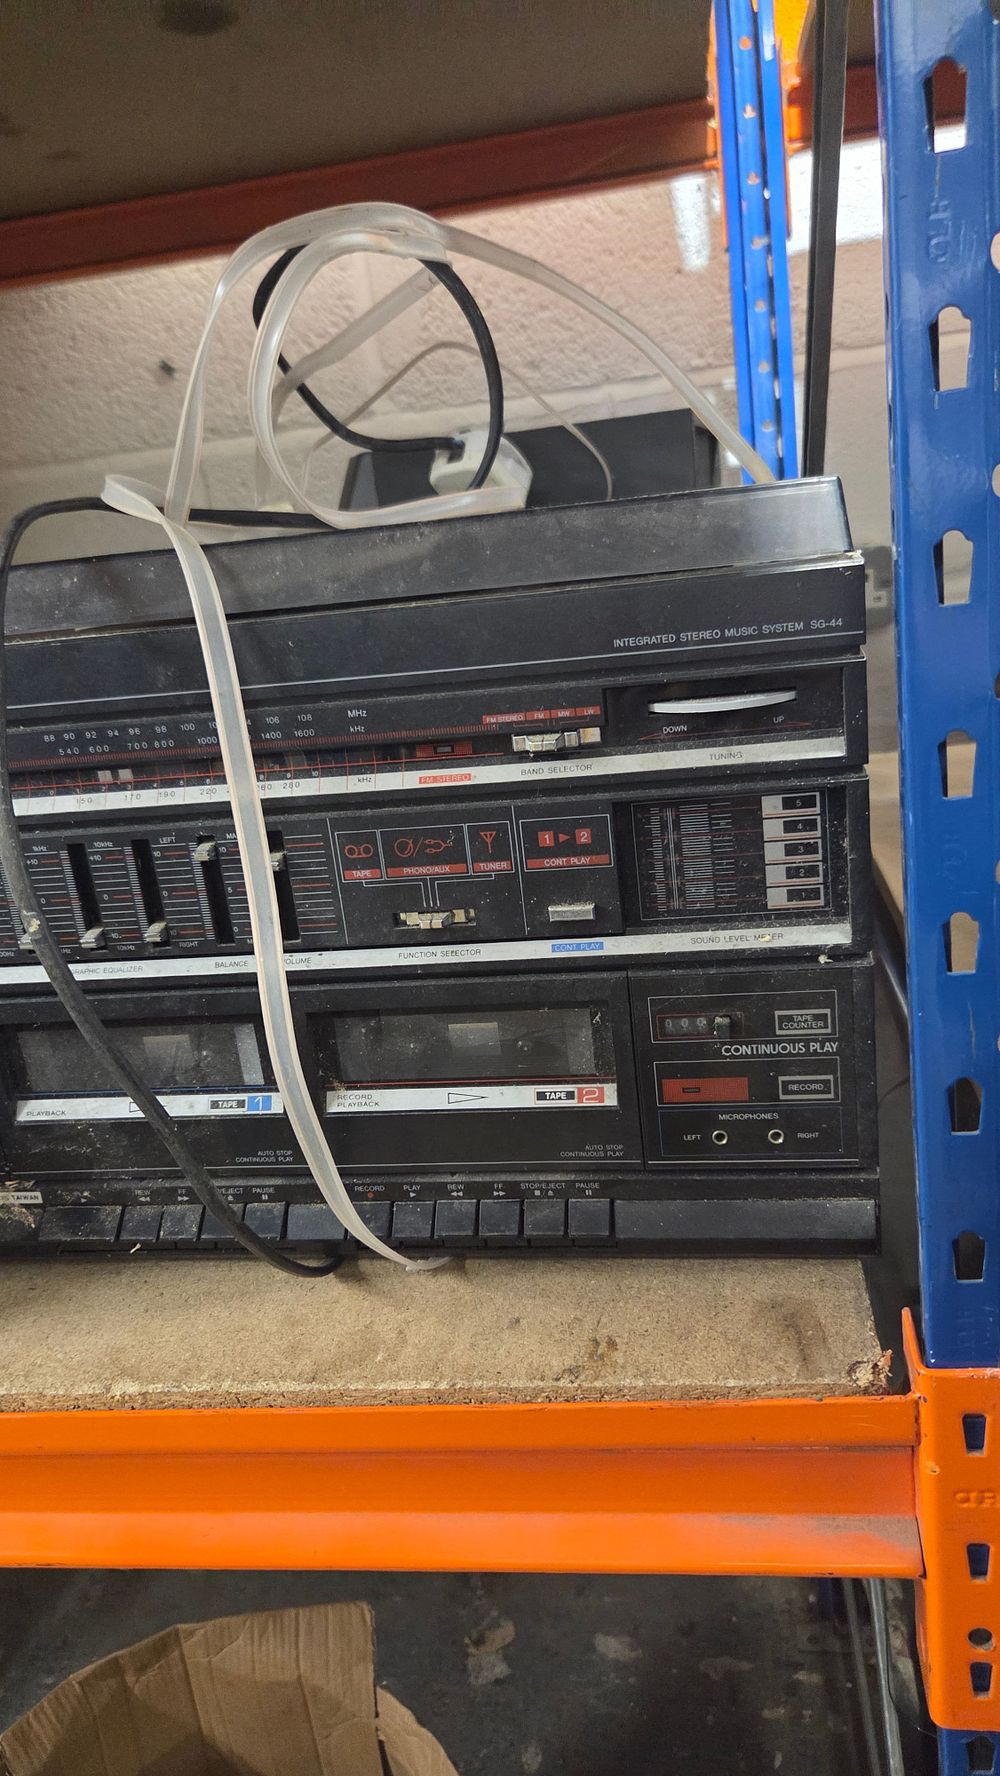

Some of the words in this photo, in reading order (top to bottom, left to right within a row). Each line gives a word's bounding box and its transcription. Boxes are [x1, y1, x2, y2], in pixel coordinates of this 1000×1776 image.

[614, 634, 676, 648] INTEGRATED
[680, 630, 720, 642] STEREO
[725, 626, 758, 638] MUSIC
[762, 622, 804, 634] SYSTEM
[810, 618, 843, 630] SG-44
[498, 714, 524, 722] STEREO
[773, 715, 785, 724] UP
[63, 732, 76, 740] 90
[85, 731, 97, 740] 92
[107, 729, 119, 738] 94
[128, 728, 141, 736] 96
[154, 725, 168, 734] 98
[180, 722, 196, 731] 100
[208, 721, 218, 729] 10
[266, 716, 280, 724] 106
[297, 714, 313, 722] 108
[348, 709, 368, 718] MHz
[662, 724, 688, 735] DOWN
[58, 747, 80, 756] 540
[89, 744, 110, 754] 600
[127, 742, 148, 750] 700
[154, 740, 175, 748] 800
[197, 736, 218, 744] 1000
[261, 731, 282, 740] 1400
[294, 728, 315, 738] 1600
[350, 724, 365, 732] kHz
[709, 750, 744, 761] TUNING
[520, 767, 545, 776] BAND
[548, 764, 593, 774] SELECTOR
[420, 775, 435, 784] FM
[436, 773, 470, 784] STEREO
[200, 787, 218, 795] 220
[357, 776, 372, 784] kHz
[544, 858, 568, 866] CONT
[570, 856, 592, 866] PLAY
[403, 864, 451, 874] PHONO/AUX
[479, 862, 508, 871] TUNER
[352, 870, 372, 878] TAPE
[800, 868, 806, 876] 2
[690, 935, 721, 945] SOUND
[724, 934, 752, 943] LEVEL
[554, 944, 578, 952] CONT
[580, 942, 600, 950] PLAY
[398, 950, 438, 960] FUNCTION
[441, 948, 481, 958] SELECTOR
[214, 960, 248, 968] BALANCE
[284, 957, 312, 965] OLUME
[104, 966, 144, 974] EQUALIZER
[782, 1020, 824, 1030] COUNTER
[722, 1042, 806, 1056] CONTINUOUS
[810, 1042, 838, 1053] PLAY
[788, 1083, 824, 1092] RECORD
[544, 1091, 568, 1100] TAPE
[582, 1086, 600, 1104] 2
[218, 1100, 238, 1108] TAPE
[254, 1096, 263, 1112] 1
[336, 1100, 380, 1109] PLAYBACK
[26, 1110, 66, 1118] PLAYBACK
[718, 1112, 780, 1121] MICROPHONES
